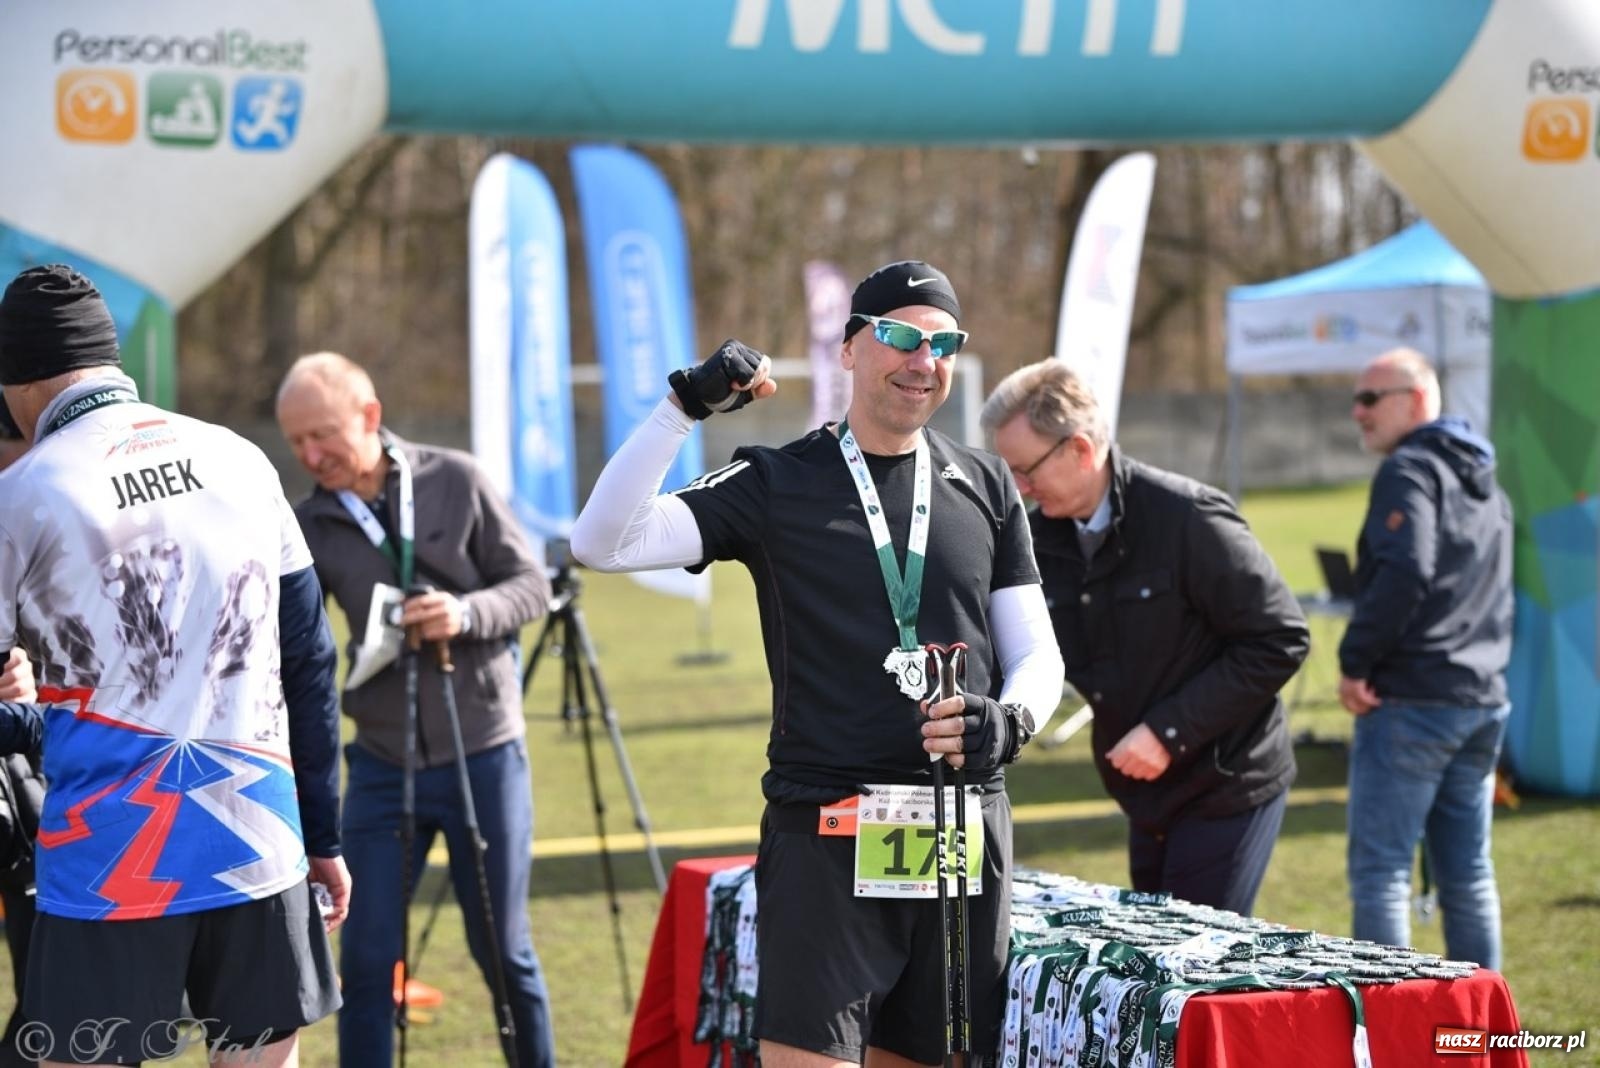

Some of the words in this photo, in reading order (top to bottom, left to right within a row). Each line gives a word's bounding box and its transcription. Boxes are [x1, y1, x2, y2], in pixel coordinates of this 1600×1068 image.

[54, 28, 308, 71] PersonalBest
[111, 458, 204, 510] JAREK
[957, 830, 967, 878] LEKI
